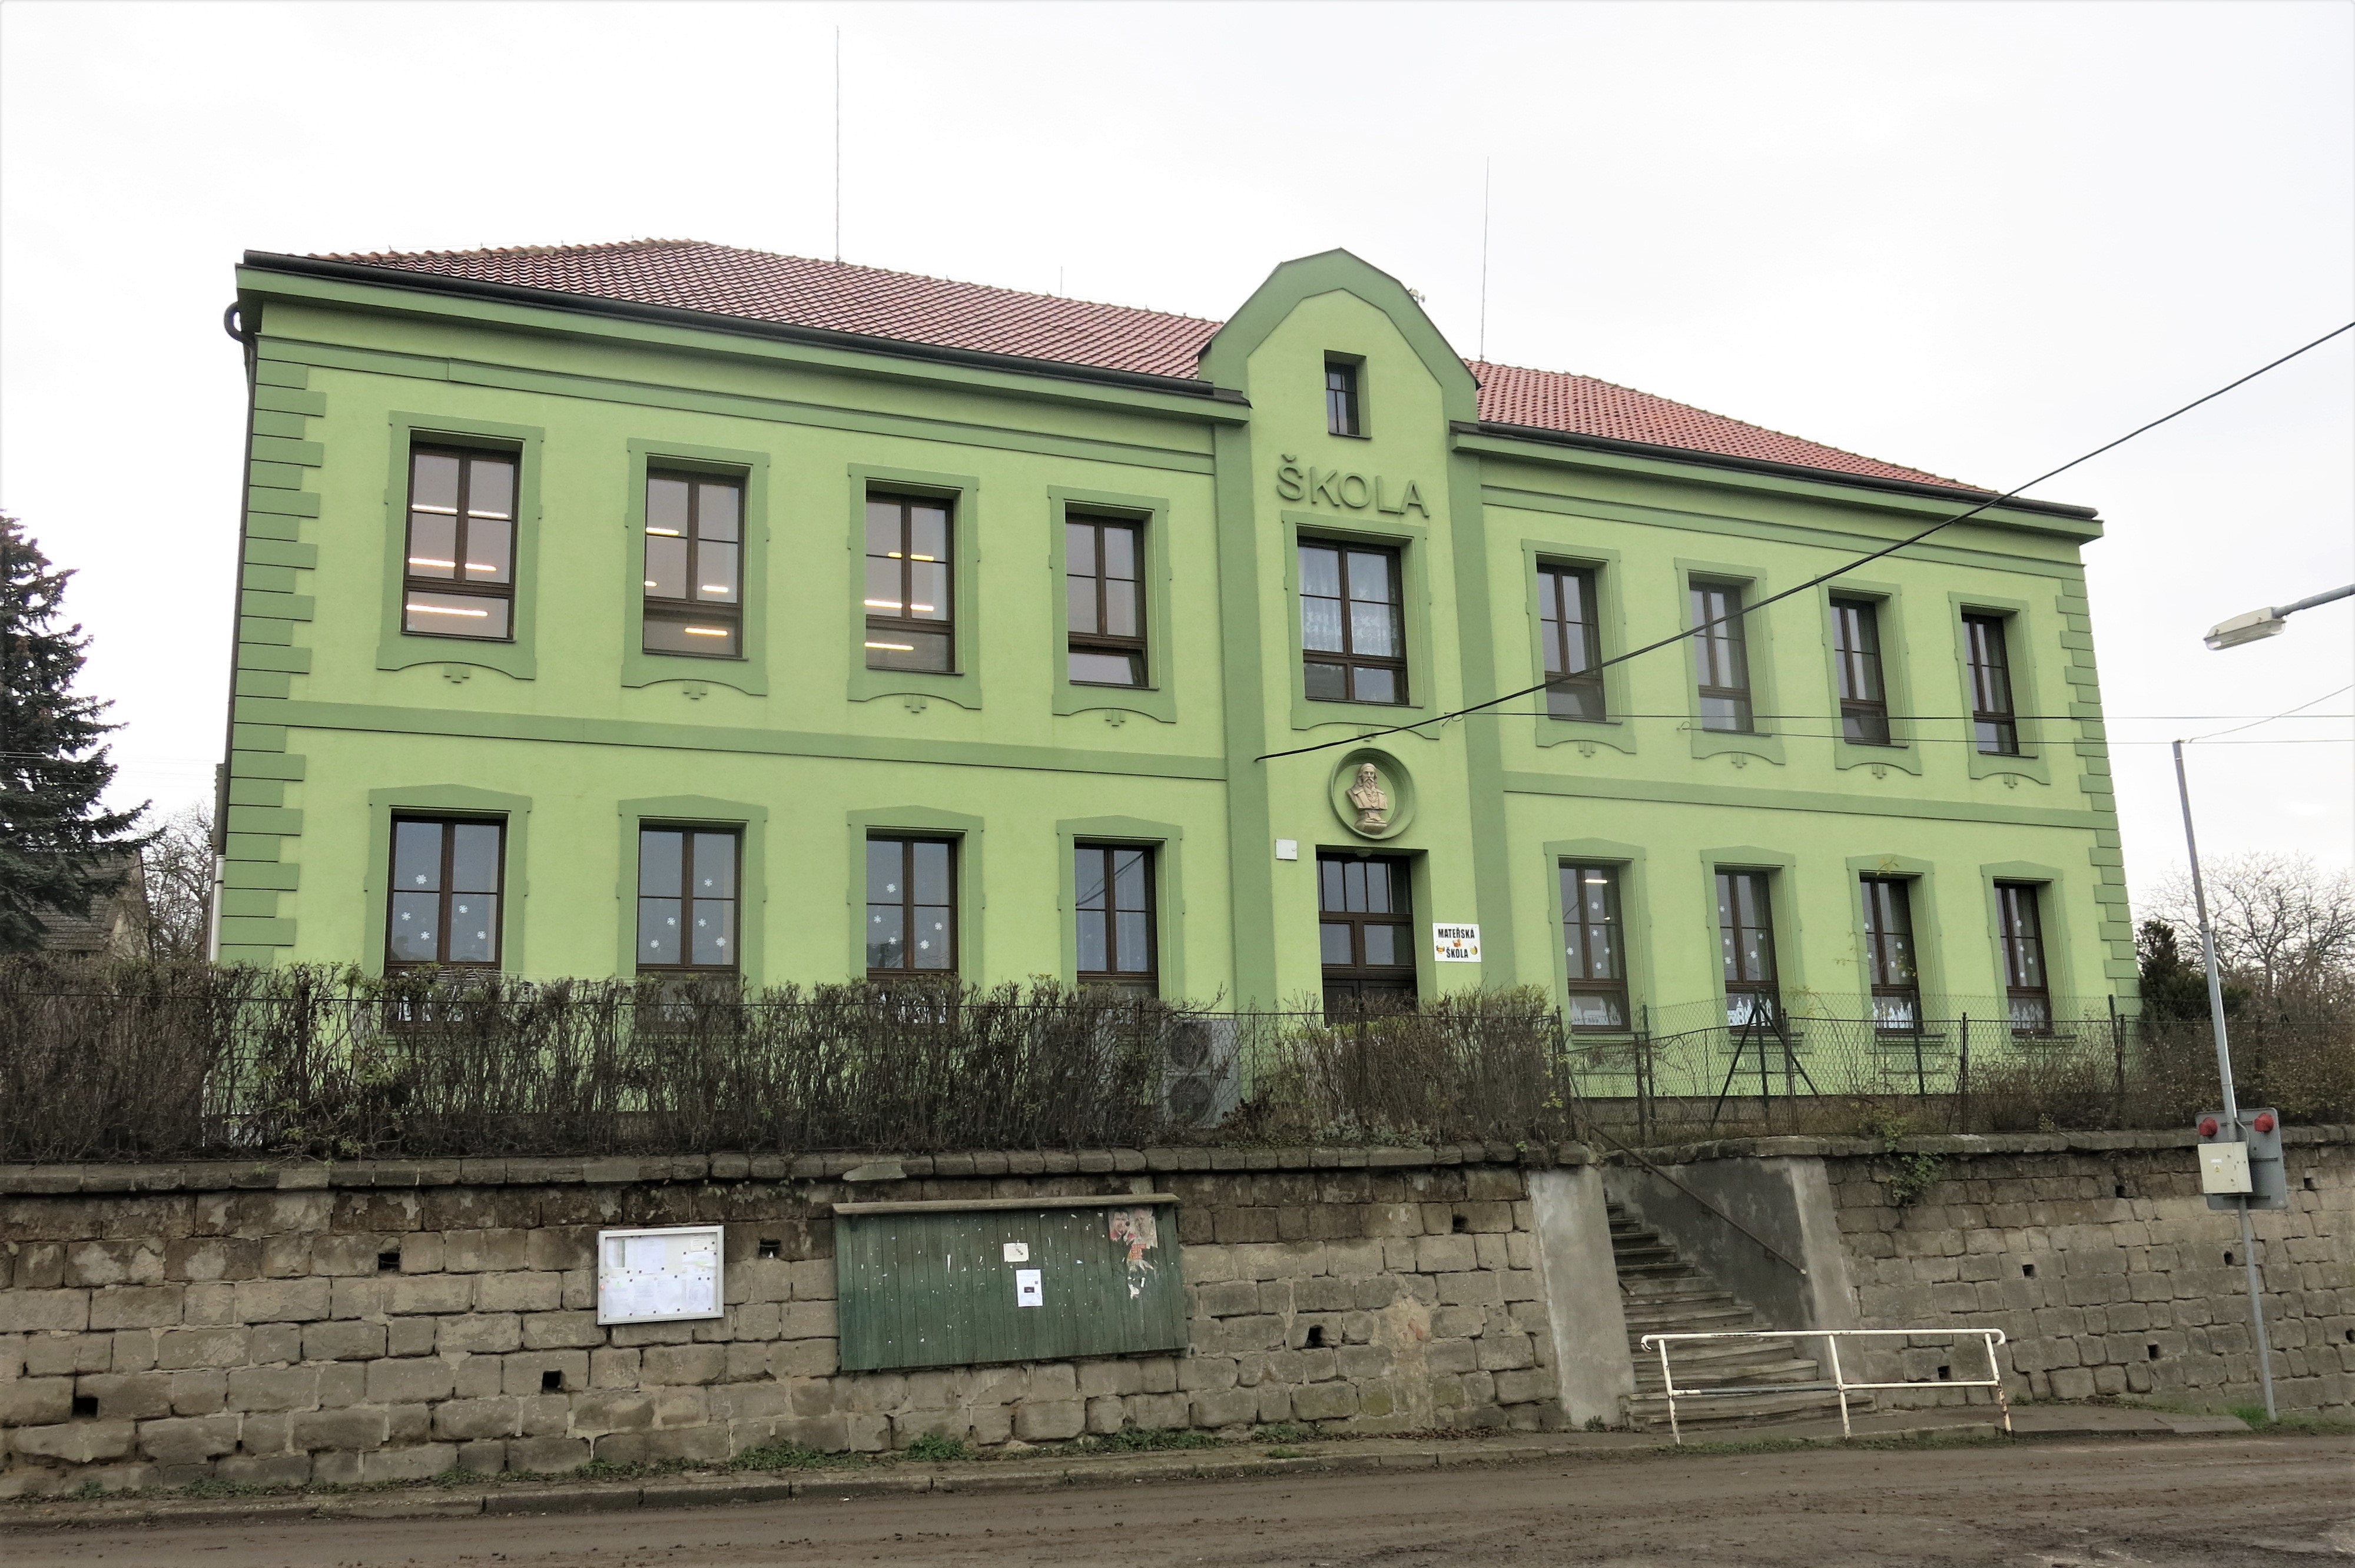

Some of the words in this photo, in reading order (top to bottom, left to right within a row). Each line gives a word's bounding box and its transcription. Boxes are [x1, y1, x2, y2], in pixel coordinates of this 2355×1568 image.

[1276, 453, 1430, 518] ŠKOLA
[1438, 927, 1475, 939] MATEŘSKÁ
[1446, 946, 1468, 958] ŠKOLA
